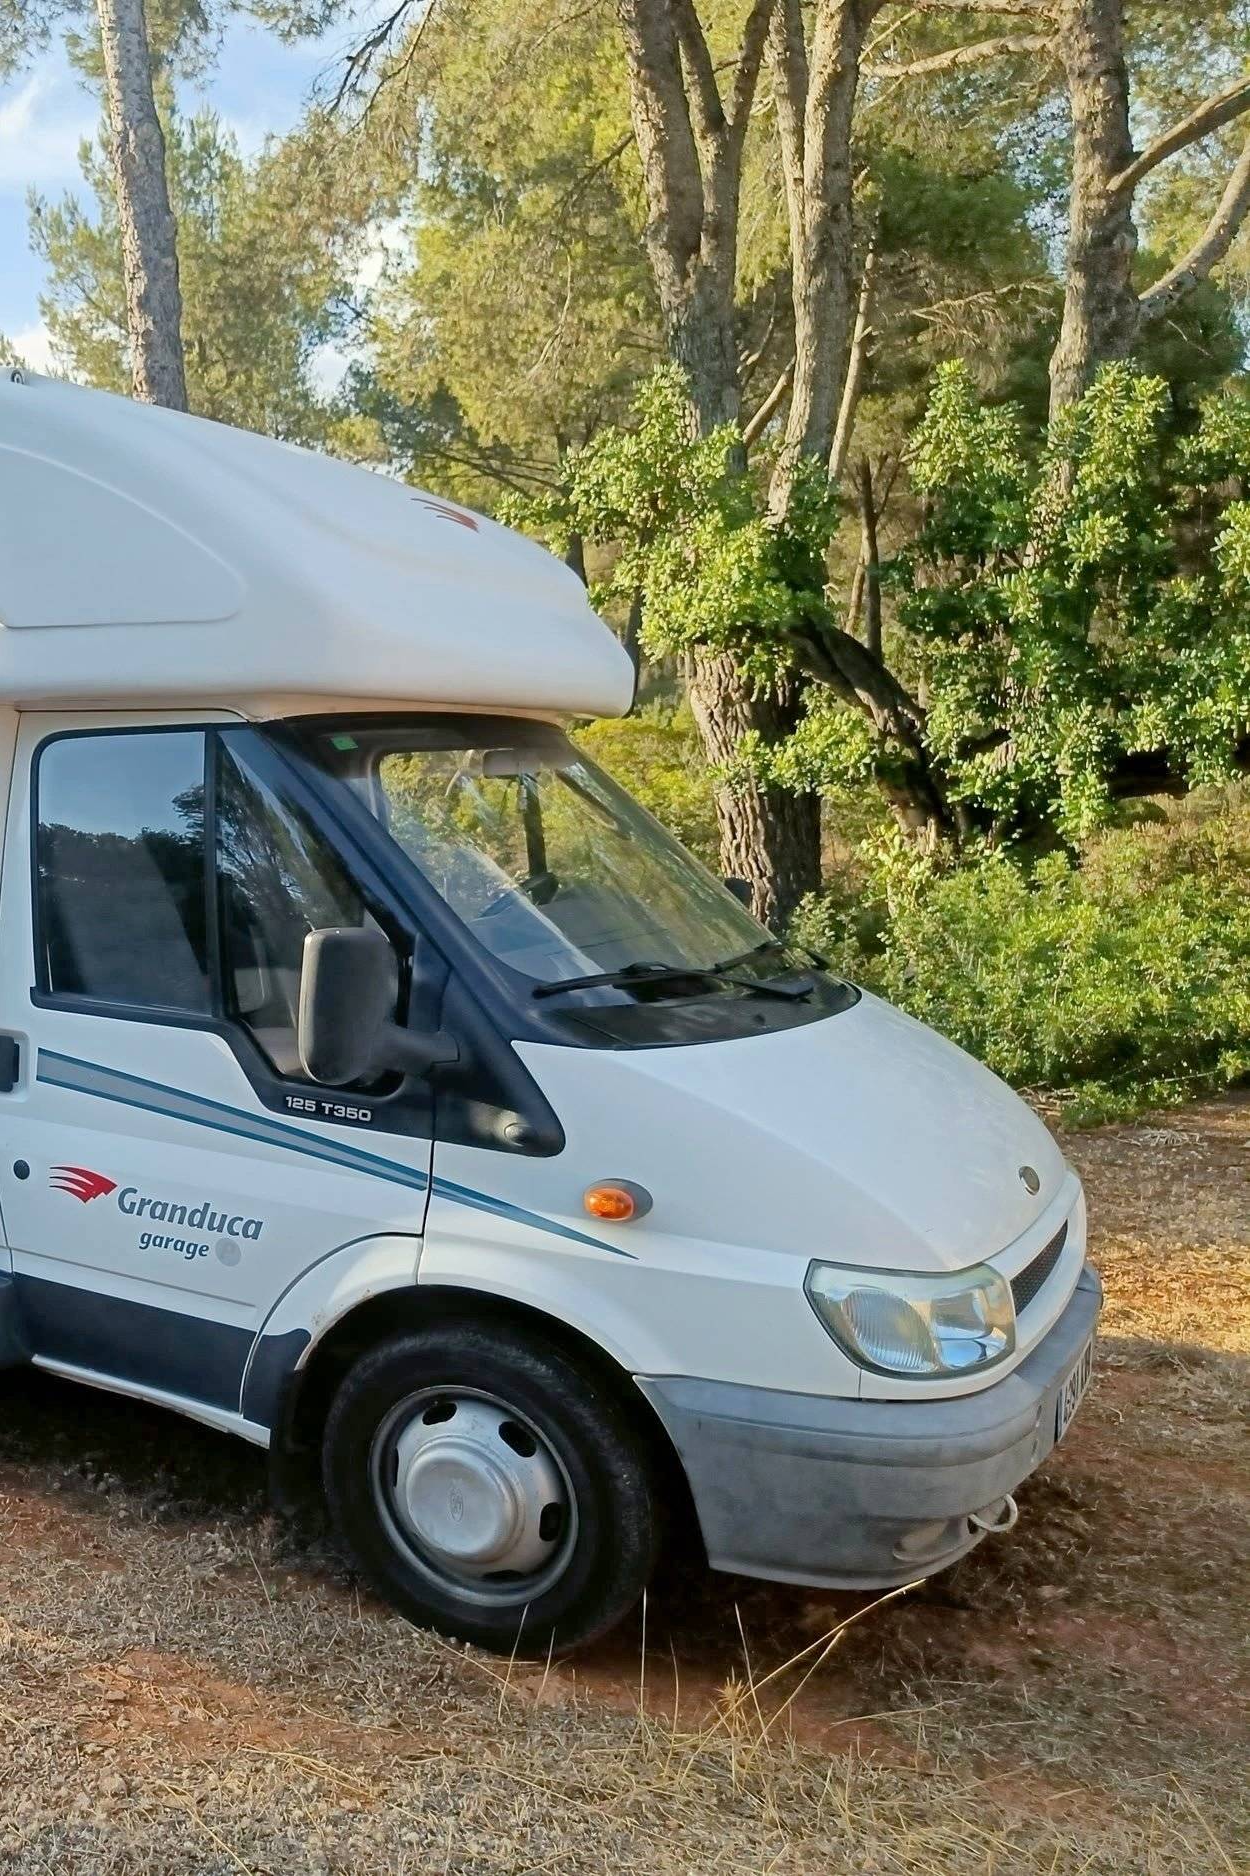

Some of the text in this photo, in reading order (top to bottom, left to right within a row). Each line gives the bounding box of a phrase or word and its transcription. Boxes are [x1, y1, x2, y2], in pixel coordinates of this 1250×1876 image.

[286, 1096, 372, 1122] 125 T350
[117, 1187, 264, 1240] Granduca
[139, 1231, 210, 1260] garage
